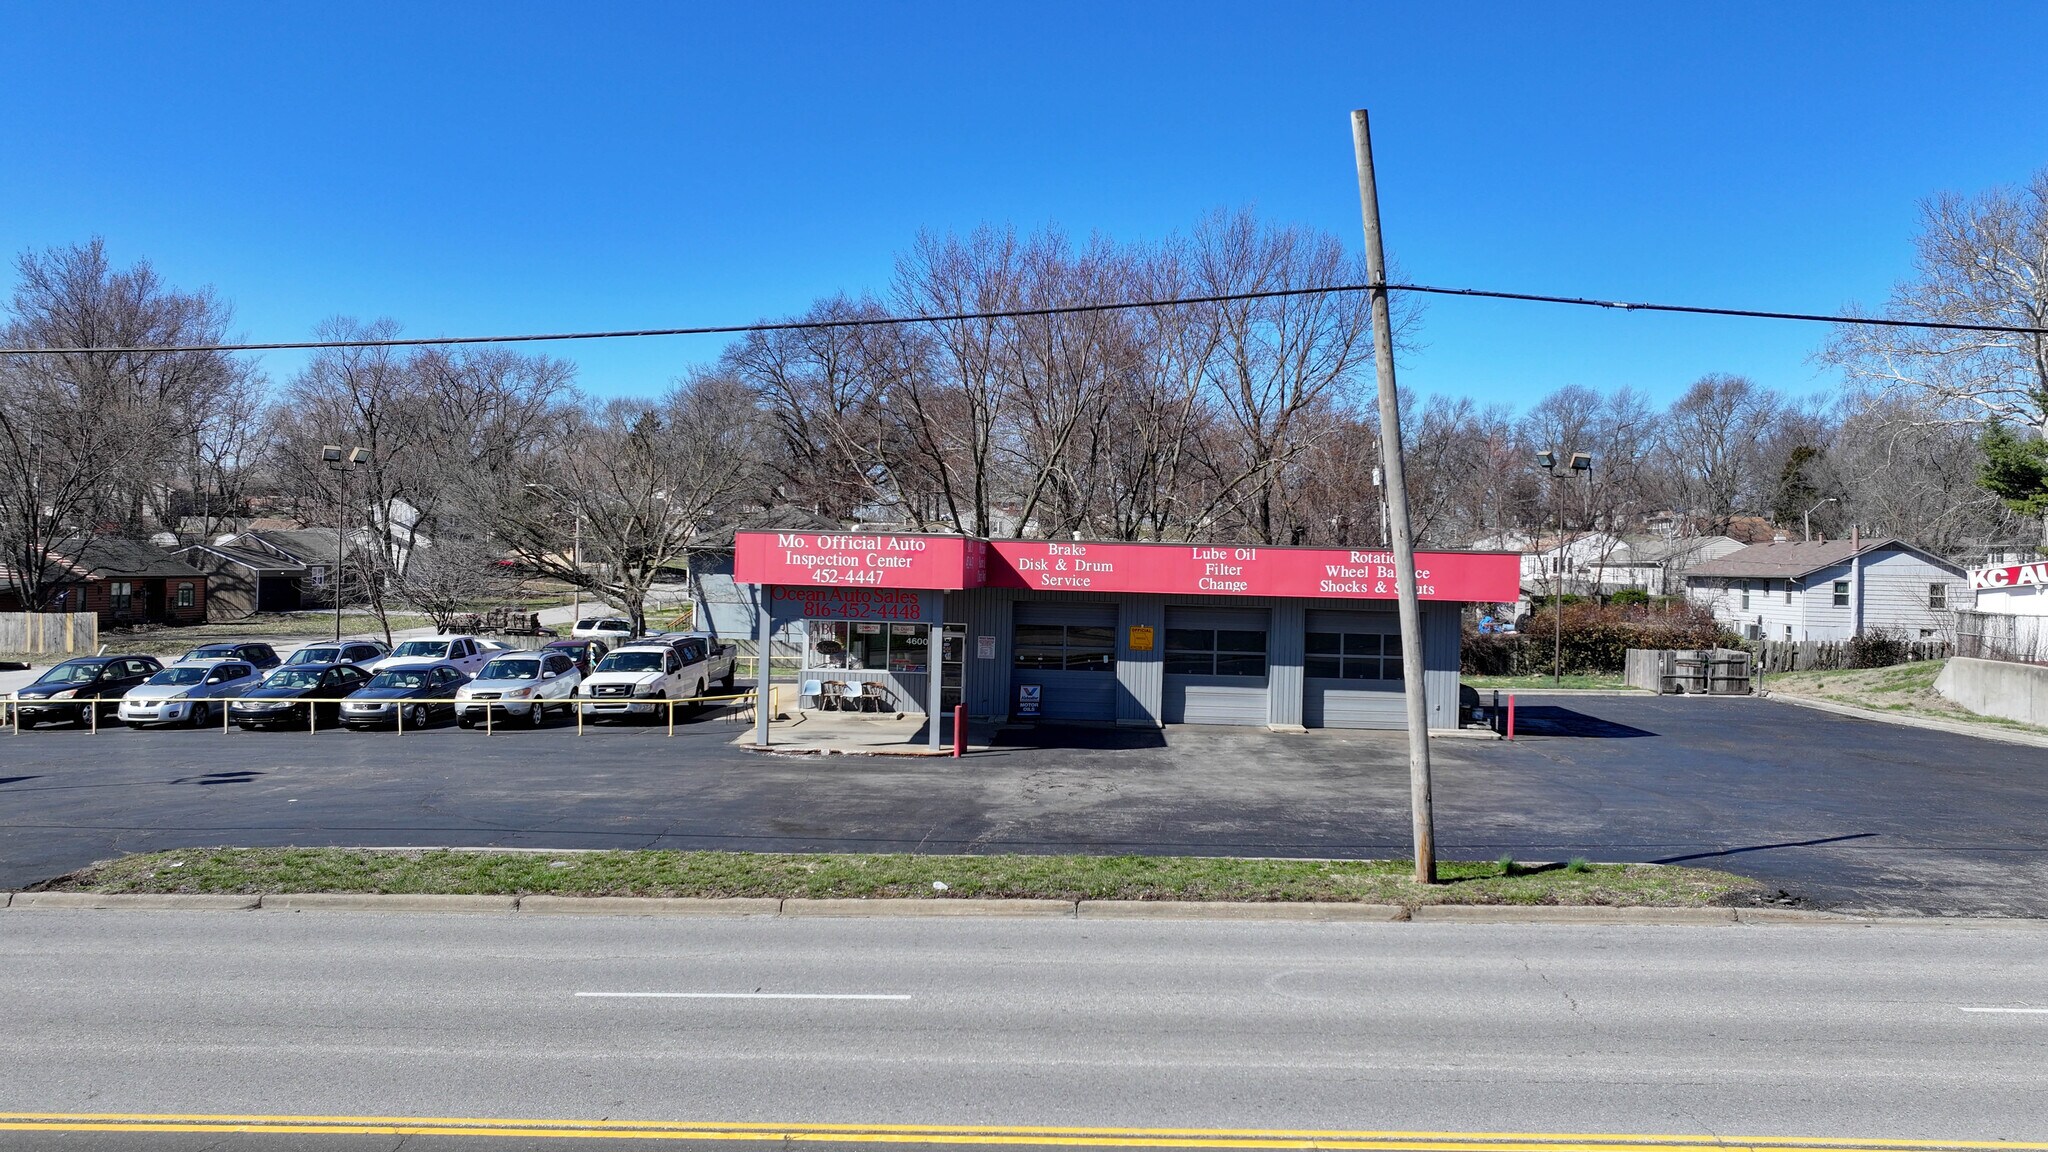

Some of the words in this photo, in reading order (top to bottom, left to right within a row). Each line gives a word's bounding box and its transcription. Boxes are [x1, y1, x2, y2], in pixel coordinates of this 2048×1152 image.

[777, 533, 809, 548] Mo.
[817, 535, 882, 550] Official
[886, 536, 926, 552] Auto
[1048, 543, 1087, 556] Brake
[785, 550, 859, 570] Inspection
[866, 553, 913, 568] Center
[1192, 547, 1228, 560] Lube
[1234, 548, 1257, 561] Oil
[1350, 551, 1397, 565] Rotatio
[1018, 558, 1049, 571] Disk
[1055, 558, 1068, 571] &
[1074, 559, 1114, 572] Drum
[1205, 563, 1243, 576] Filter
[1325, 565, 1370, 578] Wheel
[1376, 565, 1431, 579] Bace
[812, 568, 885, 585] 452-4447
[1041, 573, 1091, 587] Service
[1969, 569, 2009, 588] KC
[1198, 577, 1248, 592] Change
[1319, 579, 1369, 593] Shocks
[1374, 580, 1388, 594] &
[1393, 581, 1436, 595] Suts
[772, 585, 827, 601] Ocean
[829, 586, 872, 603] Auto
[873, 587, 919, 605] Sales
[804, 601, 921, 620] 816-452-4448
[905, 637, 929, 646] 4600
